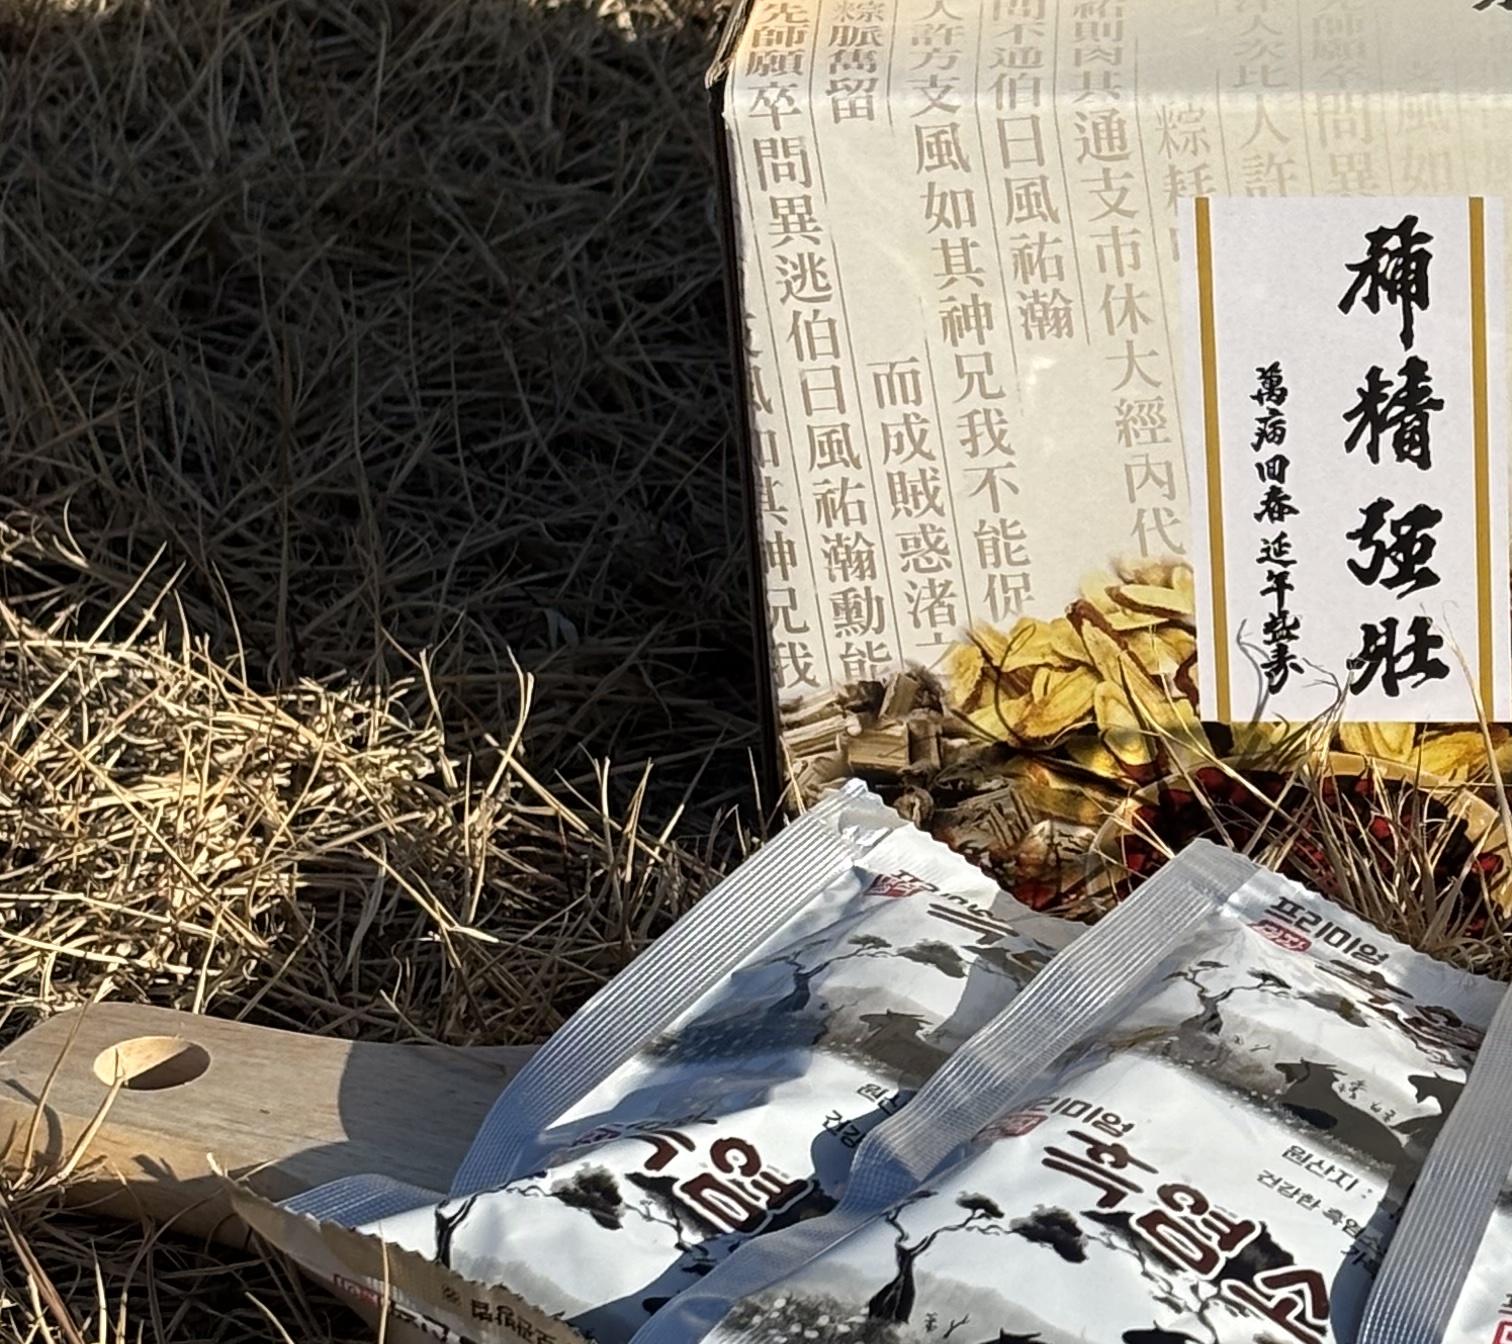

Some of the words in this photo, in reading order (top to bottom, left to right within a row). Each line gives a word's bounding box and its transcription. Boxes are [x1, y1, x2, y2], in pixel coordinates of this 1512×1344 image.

[1264, 896, 1390, 966] 프리미엄
[1256, 1169, 1322, 1212] 건강한
[1281, 1144, 1360, 1193] 원산지
